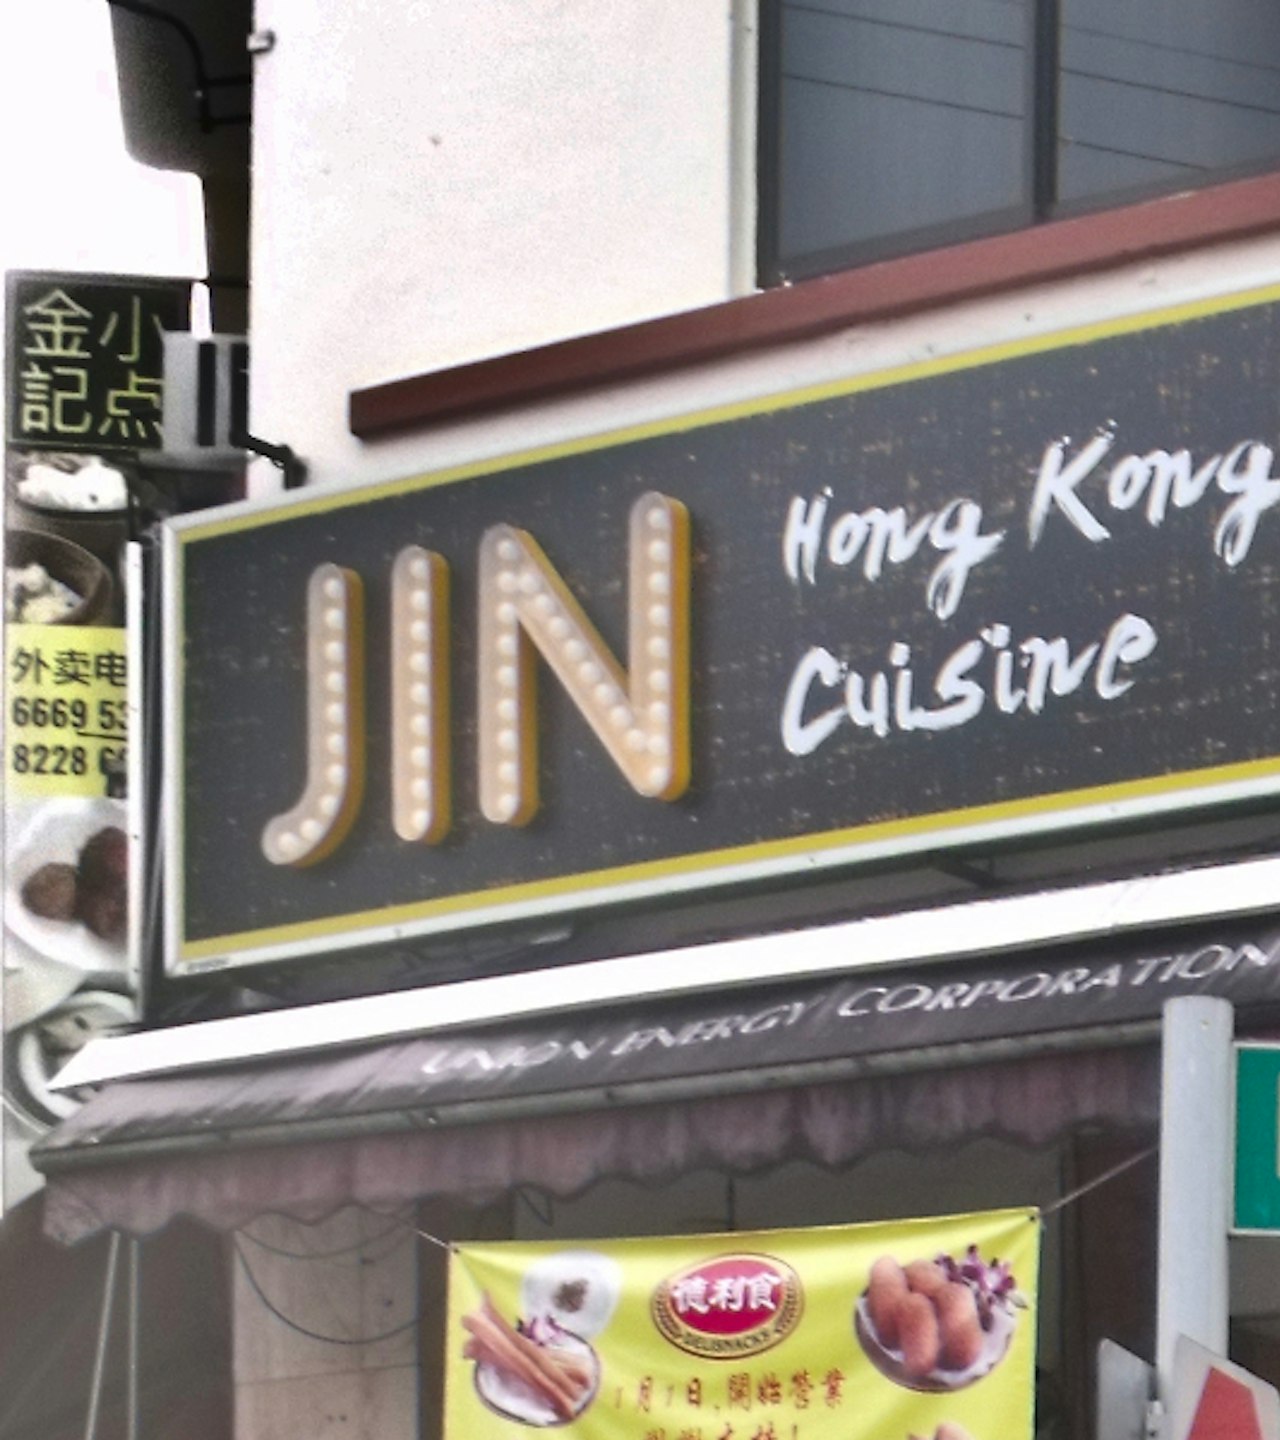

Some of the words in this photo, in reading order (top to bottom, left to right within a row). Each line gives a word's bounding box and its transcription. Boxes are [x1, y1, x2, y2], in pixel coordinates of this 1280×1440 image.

[781, 483, 1003, 621] Hong
[12, 697, 87, 728] 6669
[263, 490, 691, 869] JIN
[780, 610, 1158, 754] Cuisine
[12, 744, 87, 776] 8228
